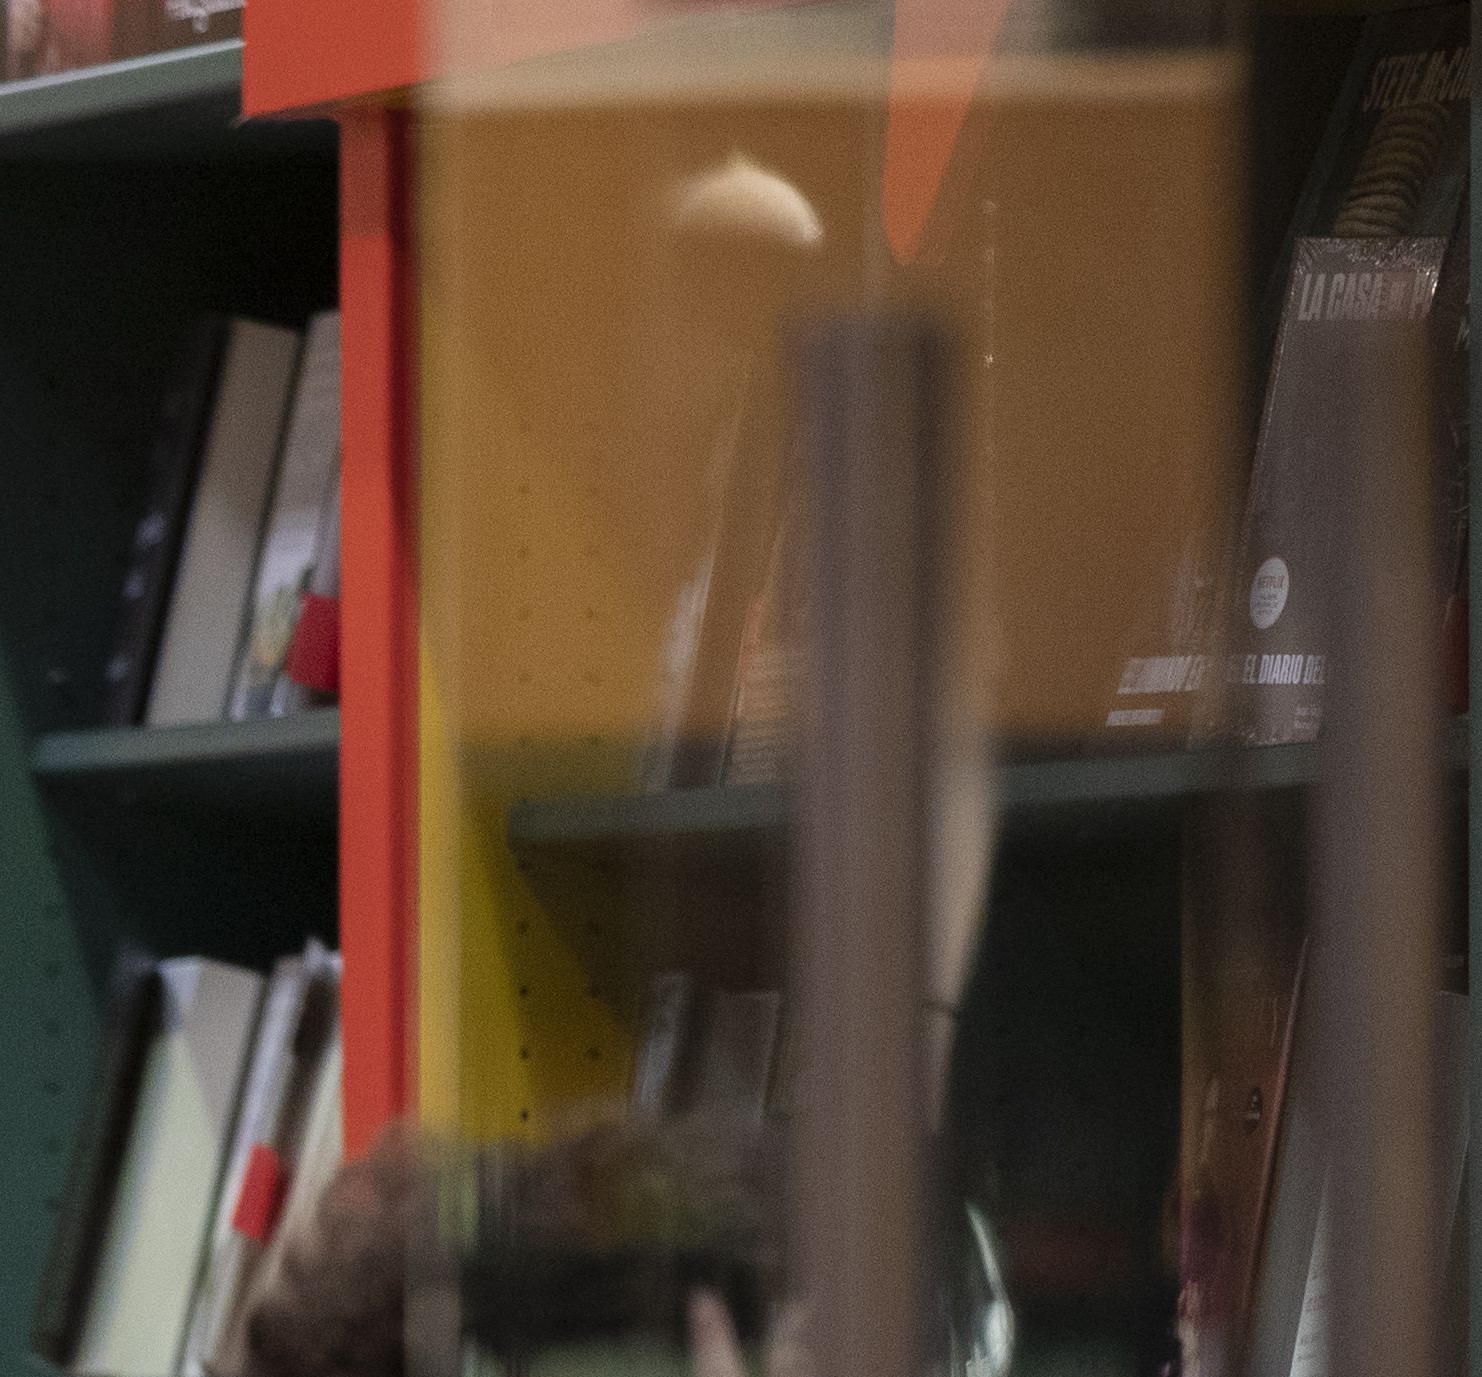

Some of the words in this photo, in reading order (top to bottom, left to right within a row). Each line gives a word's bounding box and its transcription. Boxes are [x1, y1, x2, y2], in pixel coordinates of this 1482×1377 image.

[1297, 274, 1326, 321] LA
[1327, 273, 1382, 321] CASA
[1259, 654, 1303, 684] DIARIO
